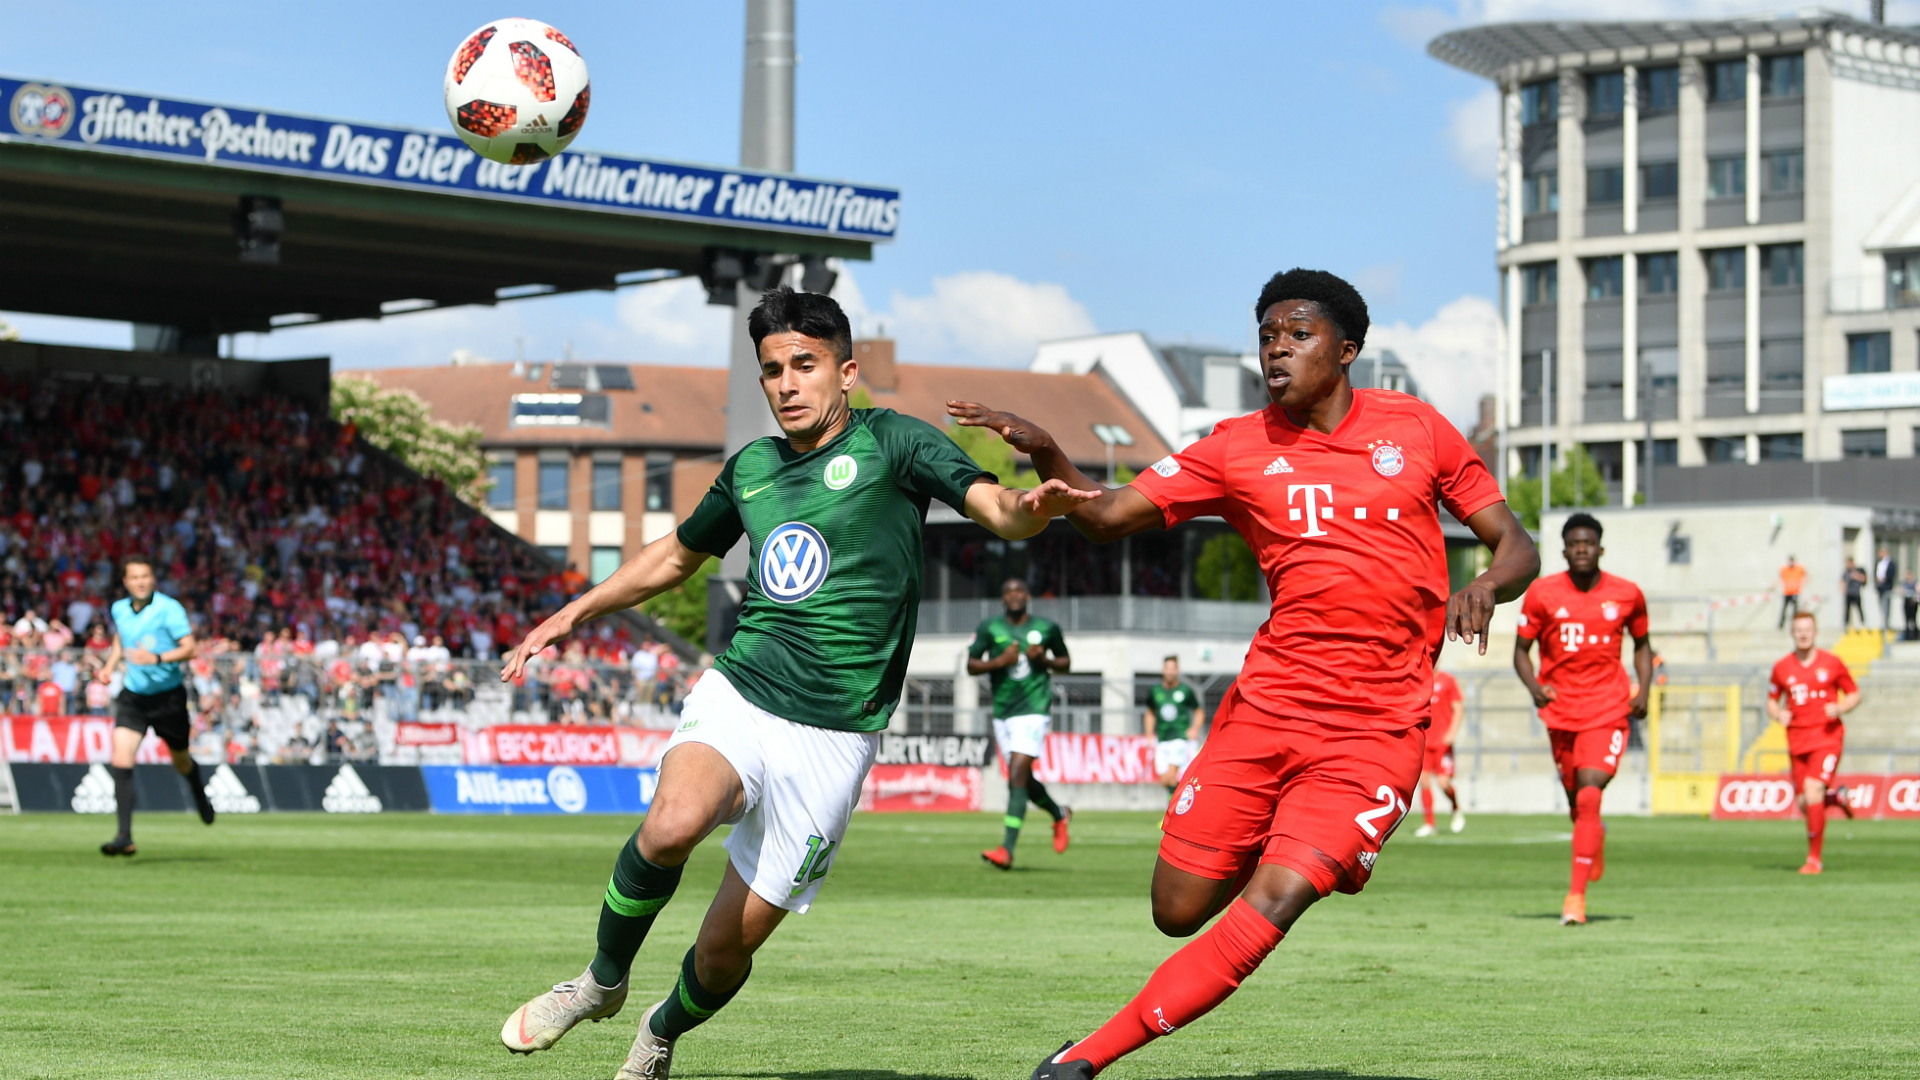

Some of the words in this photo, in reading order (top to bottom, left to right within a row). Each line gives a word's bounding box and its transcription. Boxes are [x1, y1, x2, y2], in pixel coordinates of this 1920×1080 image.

[521, 126, 552, 134] adidas
[79, 93, 317, 163] Hacker-Pschorr
[321, 124, 392, 174] Das
[396, 134, 475, 184] Bier
[475, 150, 544, 191] der
[543, 151, 714, 212] Münchner
[713, 174, 899, 233] Fußballfans
[1263, 466, 1294, 476] adidas
[497, 732, 540, 762] BFC
[540, 730, 618, 764] ZÜRICH
[1036, 733, 1156, 783] UMARKT
[1609, 729, 1623, 755] 9
[456, 770, 549, 804] Allianz
